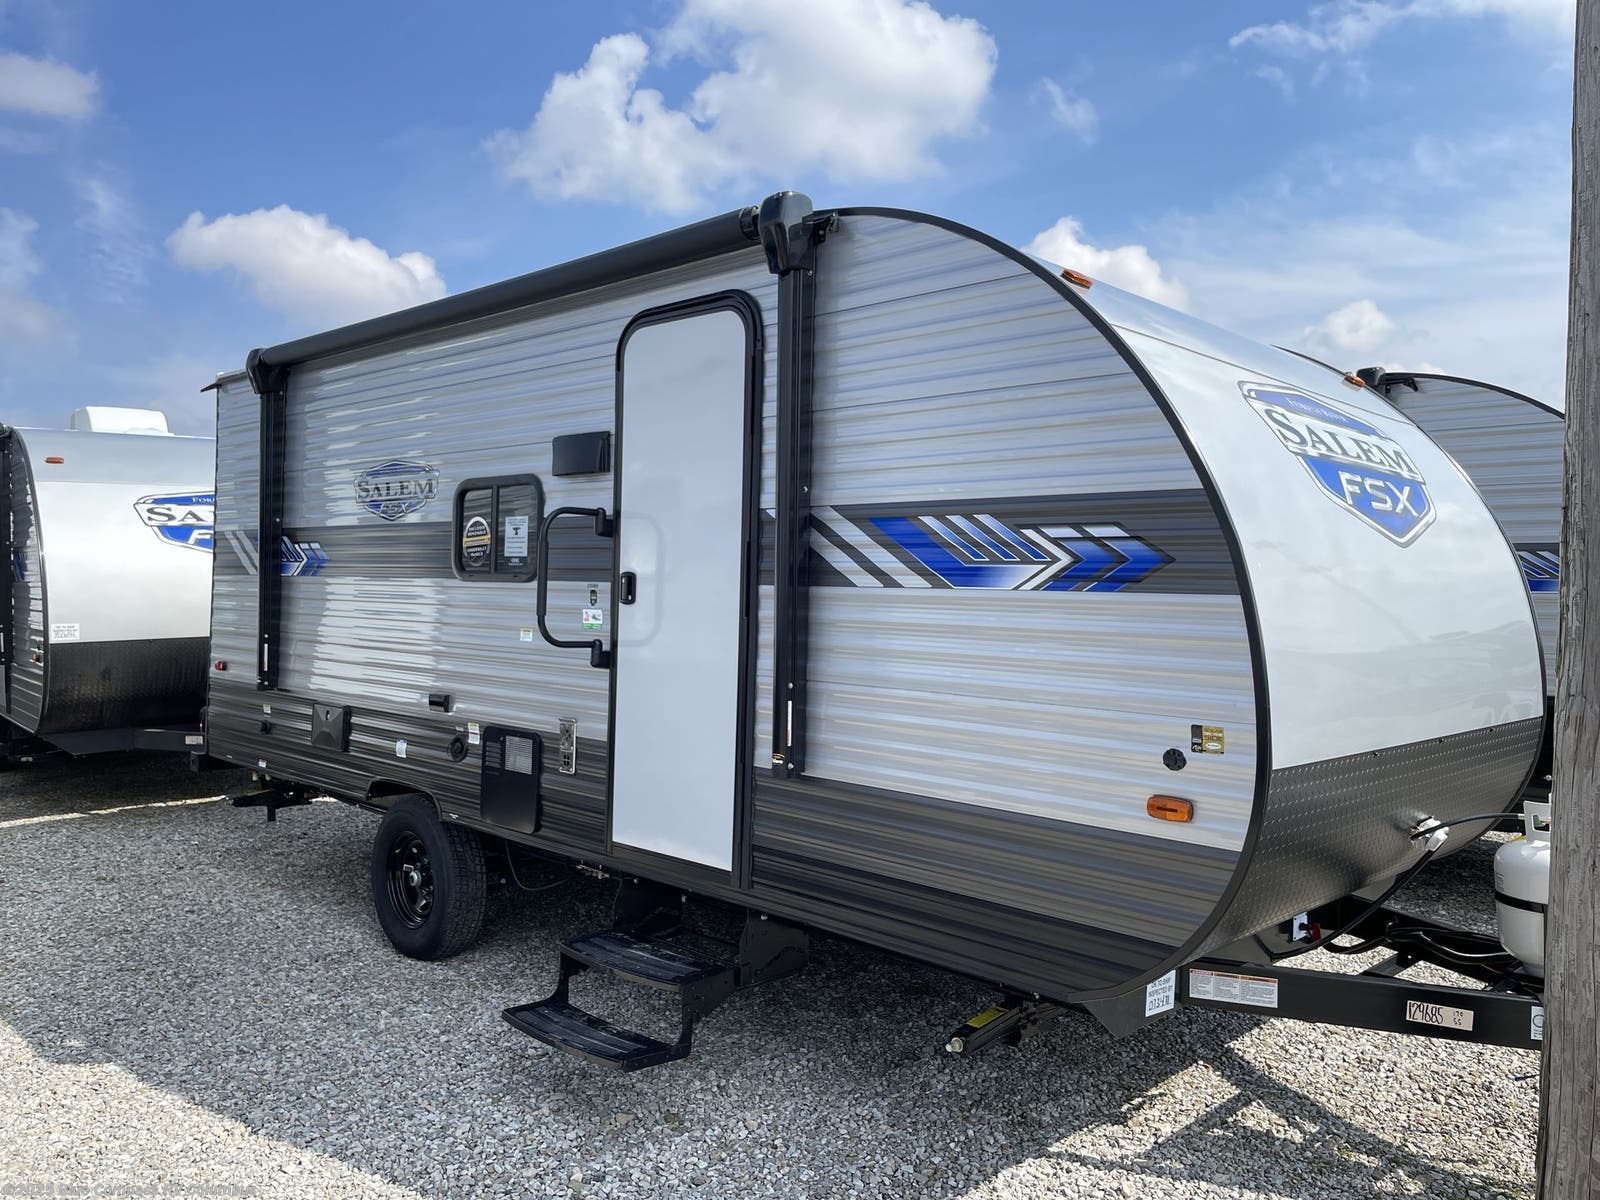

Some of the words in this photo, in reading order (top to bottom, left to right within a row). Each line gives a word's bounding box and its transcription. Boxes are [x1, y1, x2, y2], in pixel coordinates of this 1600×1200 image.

[1264, 408, 1419, 475] SALEM
[358, 478, 433, 499] SALEM
[1338, 470, 1418, 517] FSX
[1408, 1001, 1444, 1025] 129685
